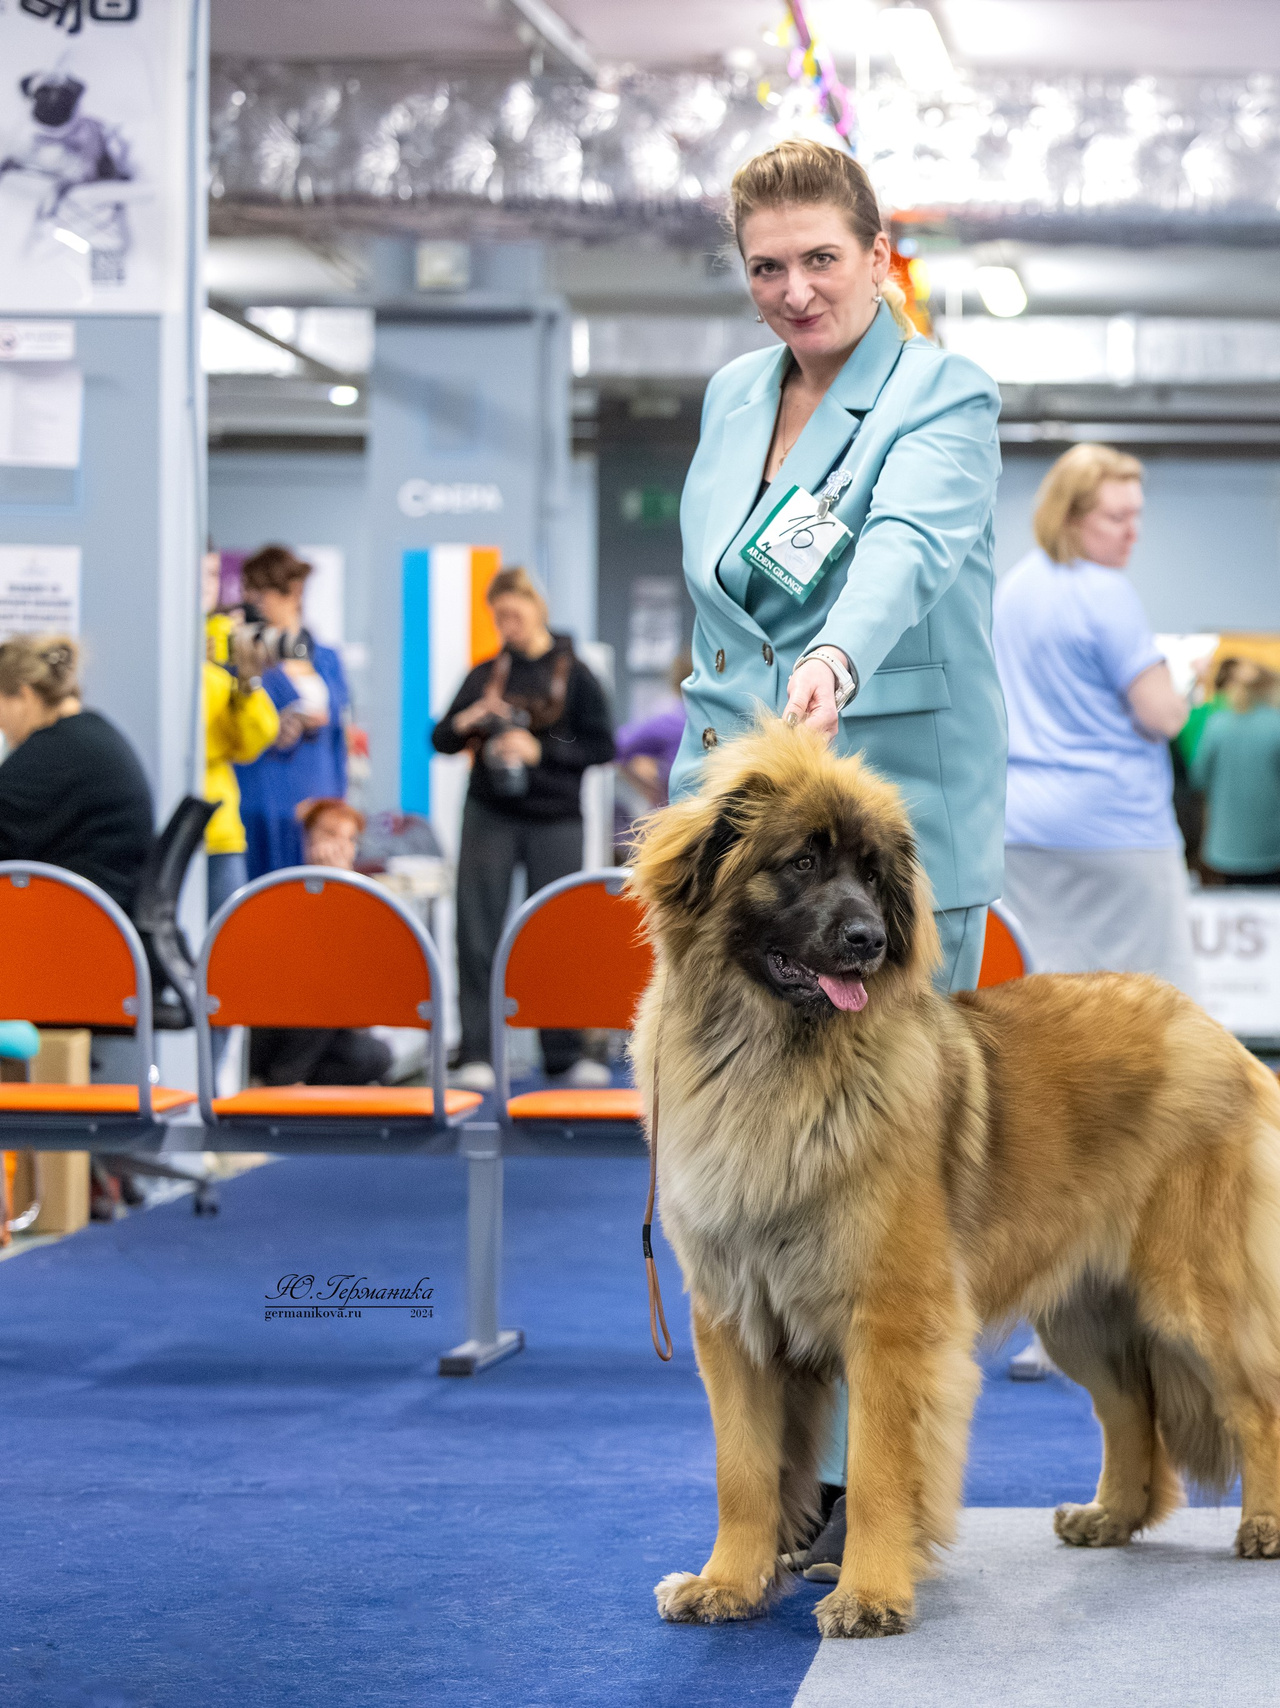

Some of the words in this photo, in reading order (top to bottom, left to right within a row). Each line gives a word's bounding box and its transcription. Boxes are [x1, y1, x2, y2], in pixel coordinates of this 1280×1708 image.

[779, 514, 836, 549] 16
[746, 546, 774, 570] ARDEN
[772, 565, 804, 595] GRANGE
